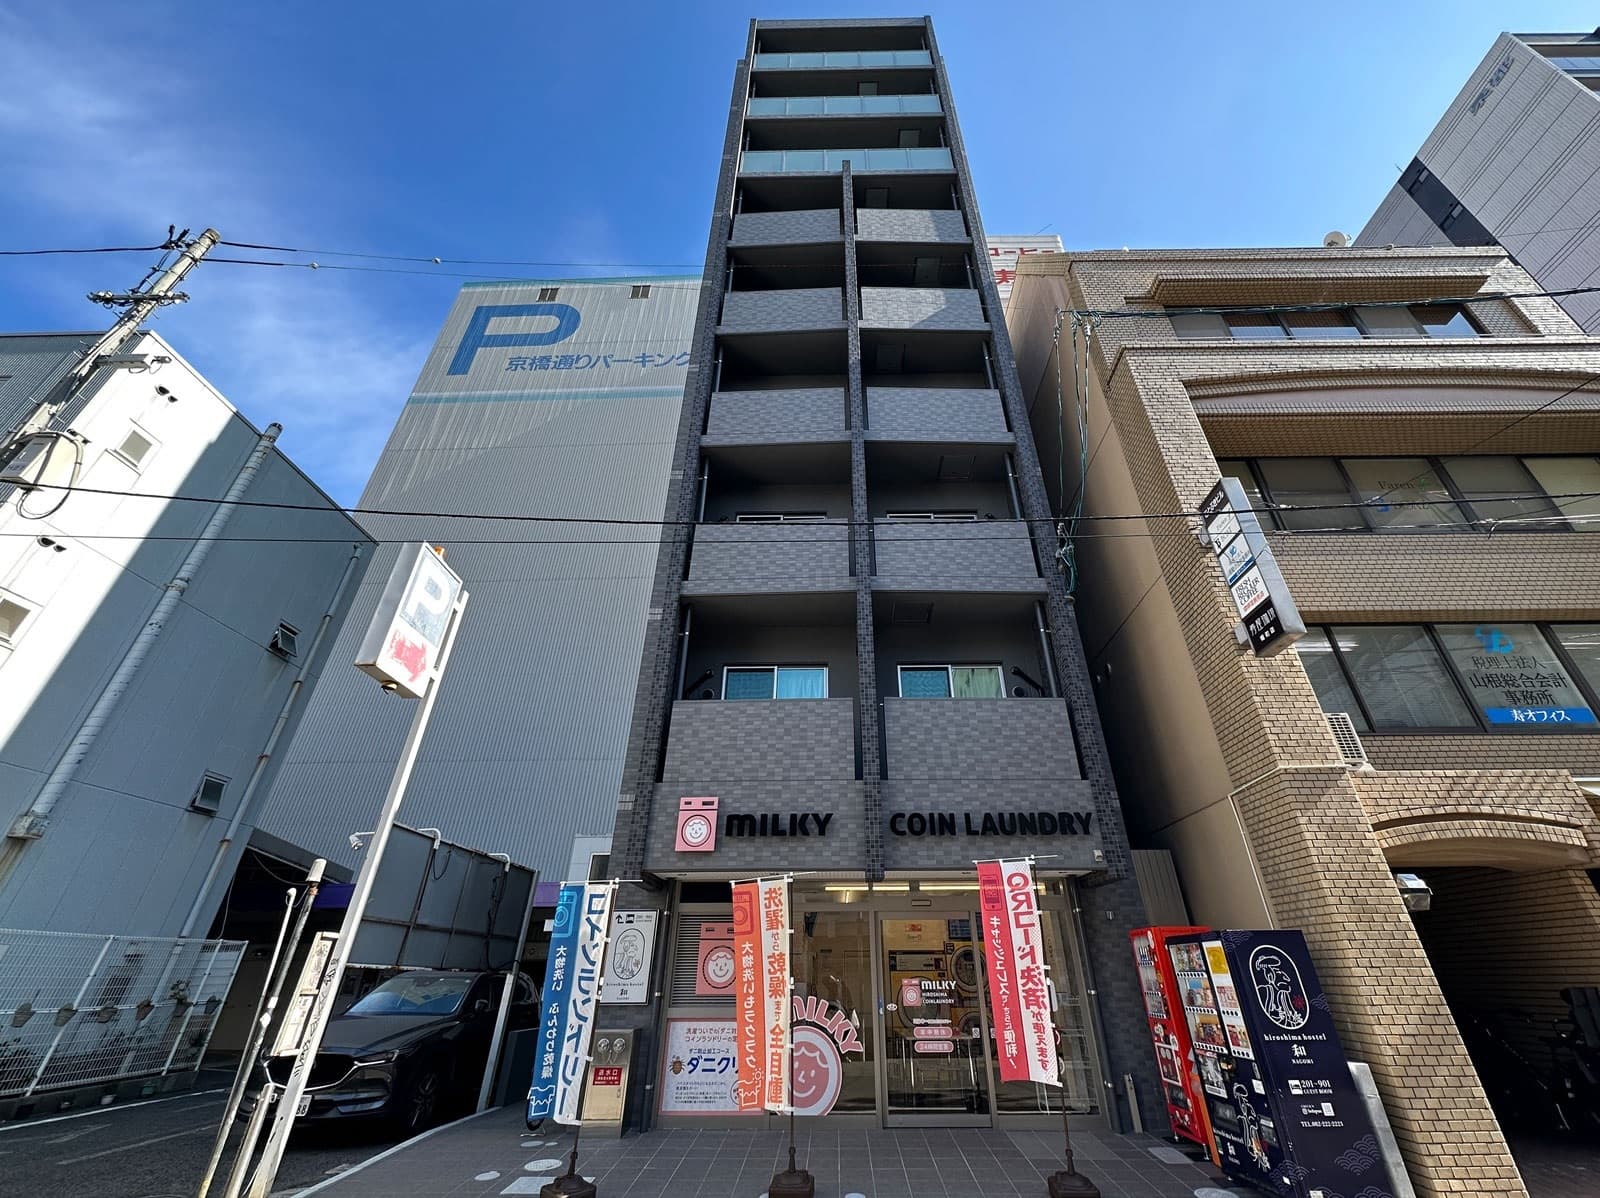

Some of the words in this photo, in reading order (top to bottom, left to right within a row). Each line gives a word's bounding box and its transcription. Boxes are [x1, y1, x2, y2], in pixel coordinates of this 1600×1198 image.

[446, 303, 581, 376] P
[405, 556, 451, 618] P
[1471, 655, 1547, 669] 税理士法人
[1468, 672, 1568, 688] 山根総合会計
[1501, 689, 1556, 705] 事務所
[1510, 708, 1571, 722] 寿オフィス
[890, 812, 956, 836] COIN
[964, 812, 1093, 836] LAUNDRY
